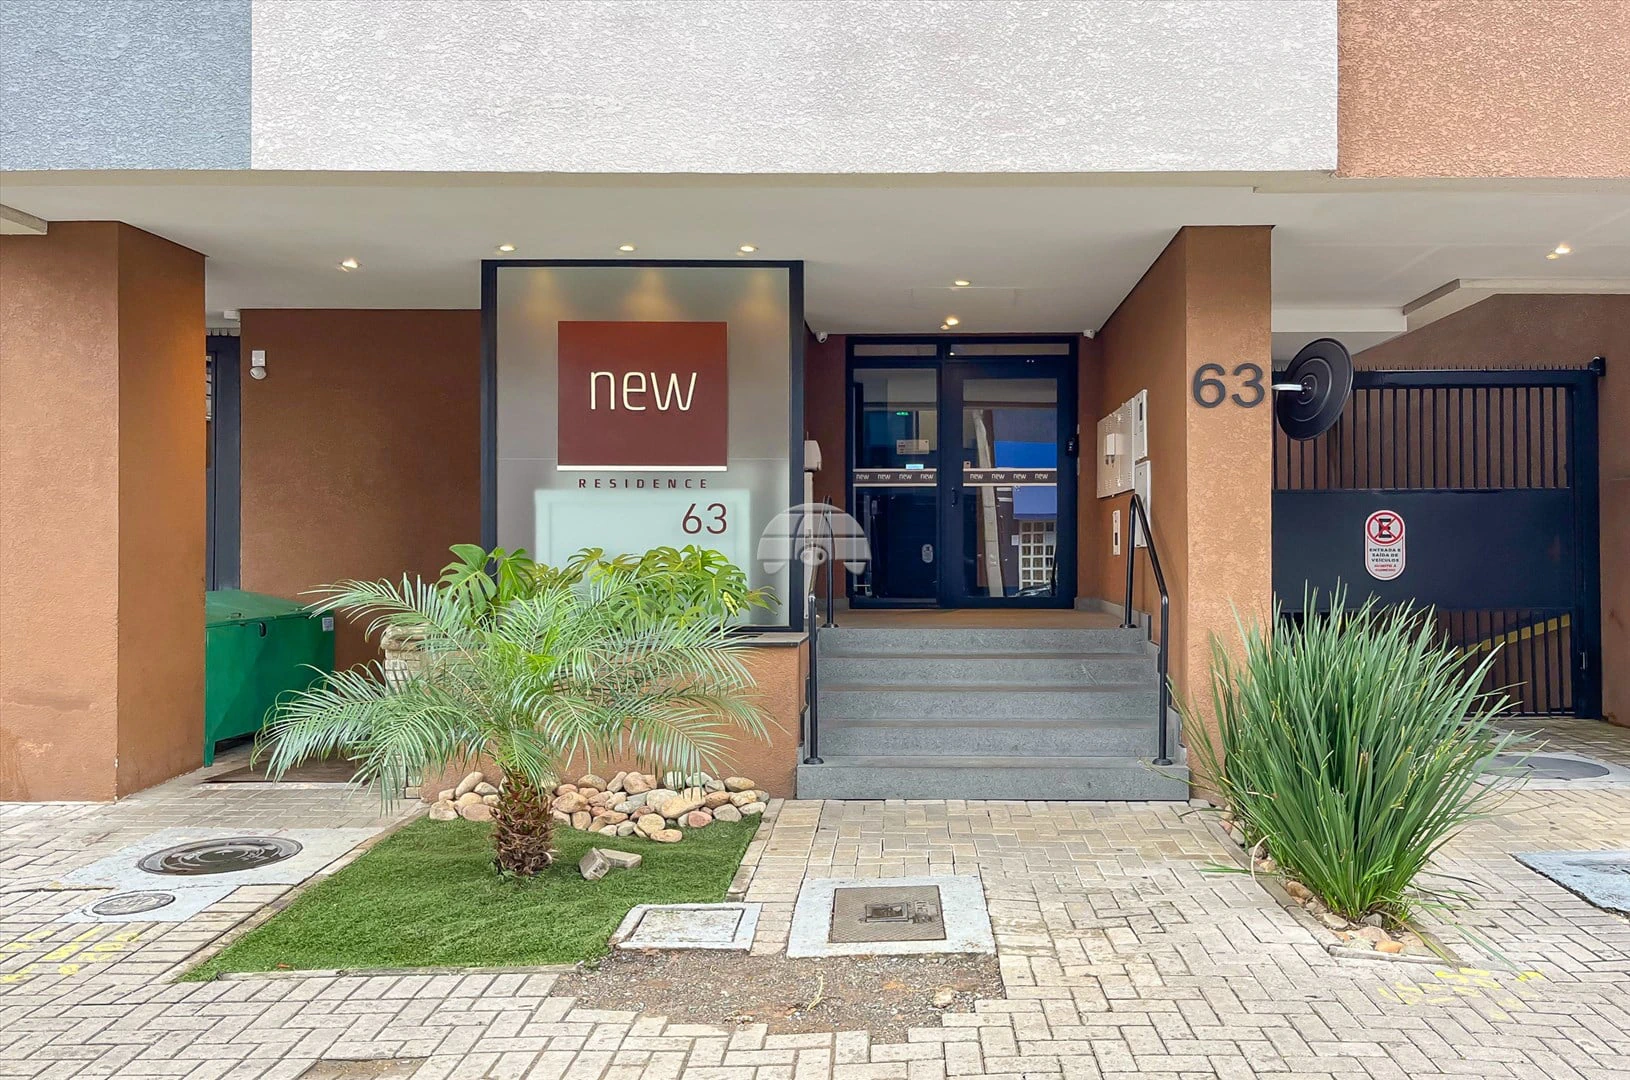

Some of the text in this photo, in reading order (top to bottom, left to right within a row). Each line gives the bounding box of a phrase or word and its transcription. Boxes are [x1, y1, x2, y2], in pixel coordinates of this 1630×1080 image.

[589, 371, 698, 412] new
[1192, 362, 1266, 409] 63
[578, 478, 708, 489] RESIDENCE
[681, 502, 728, 535] 63
